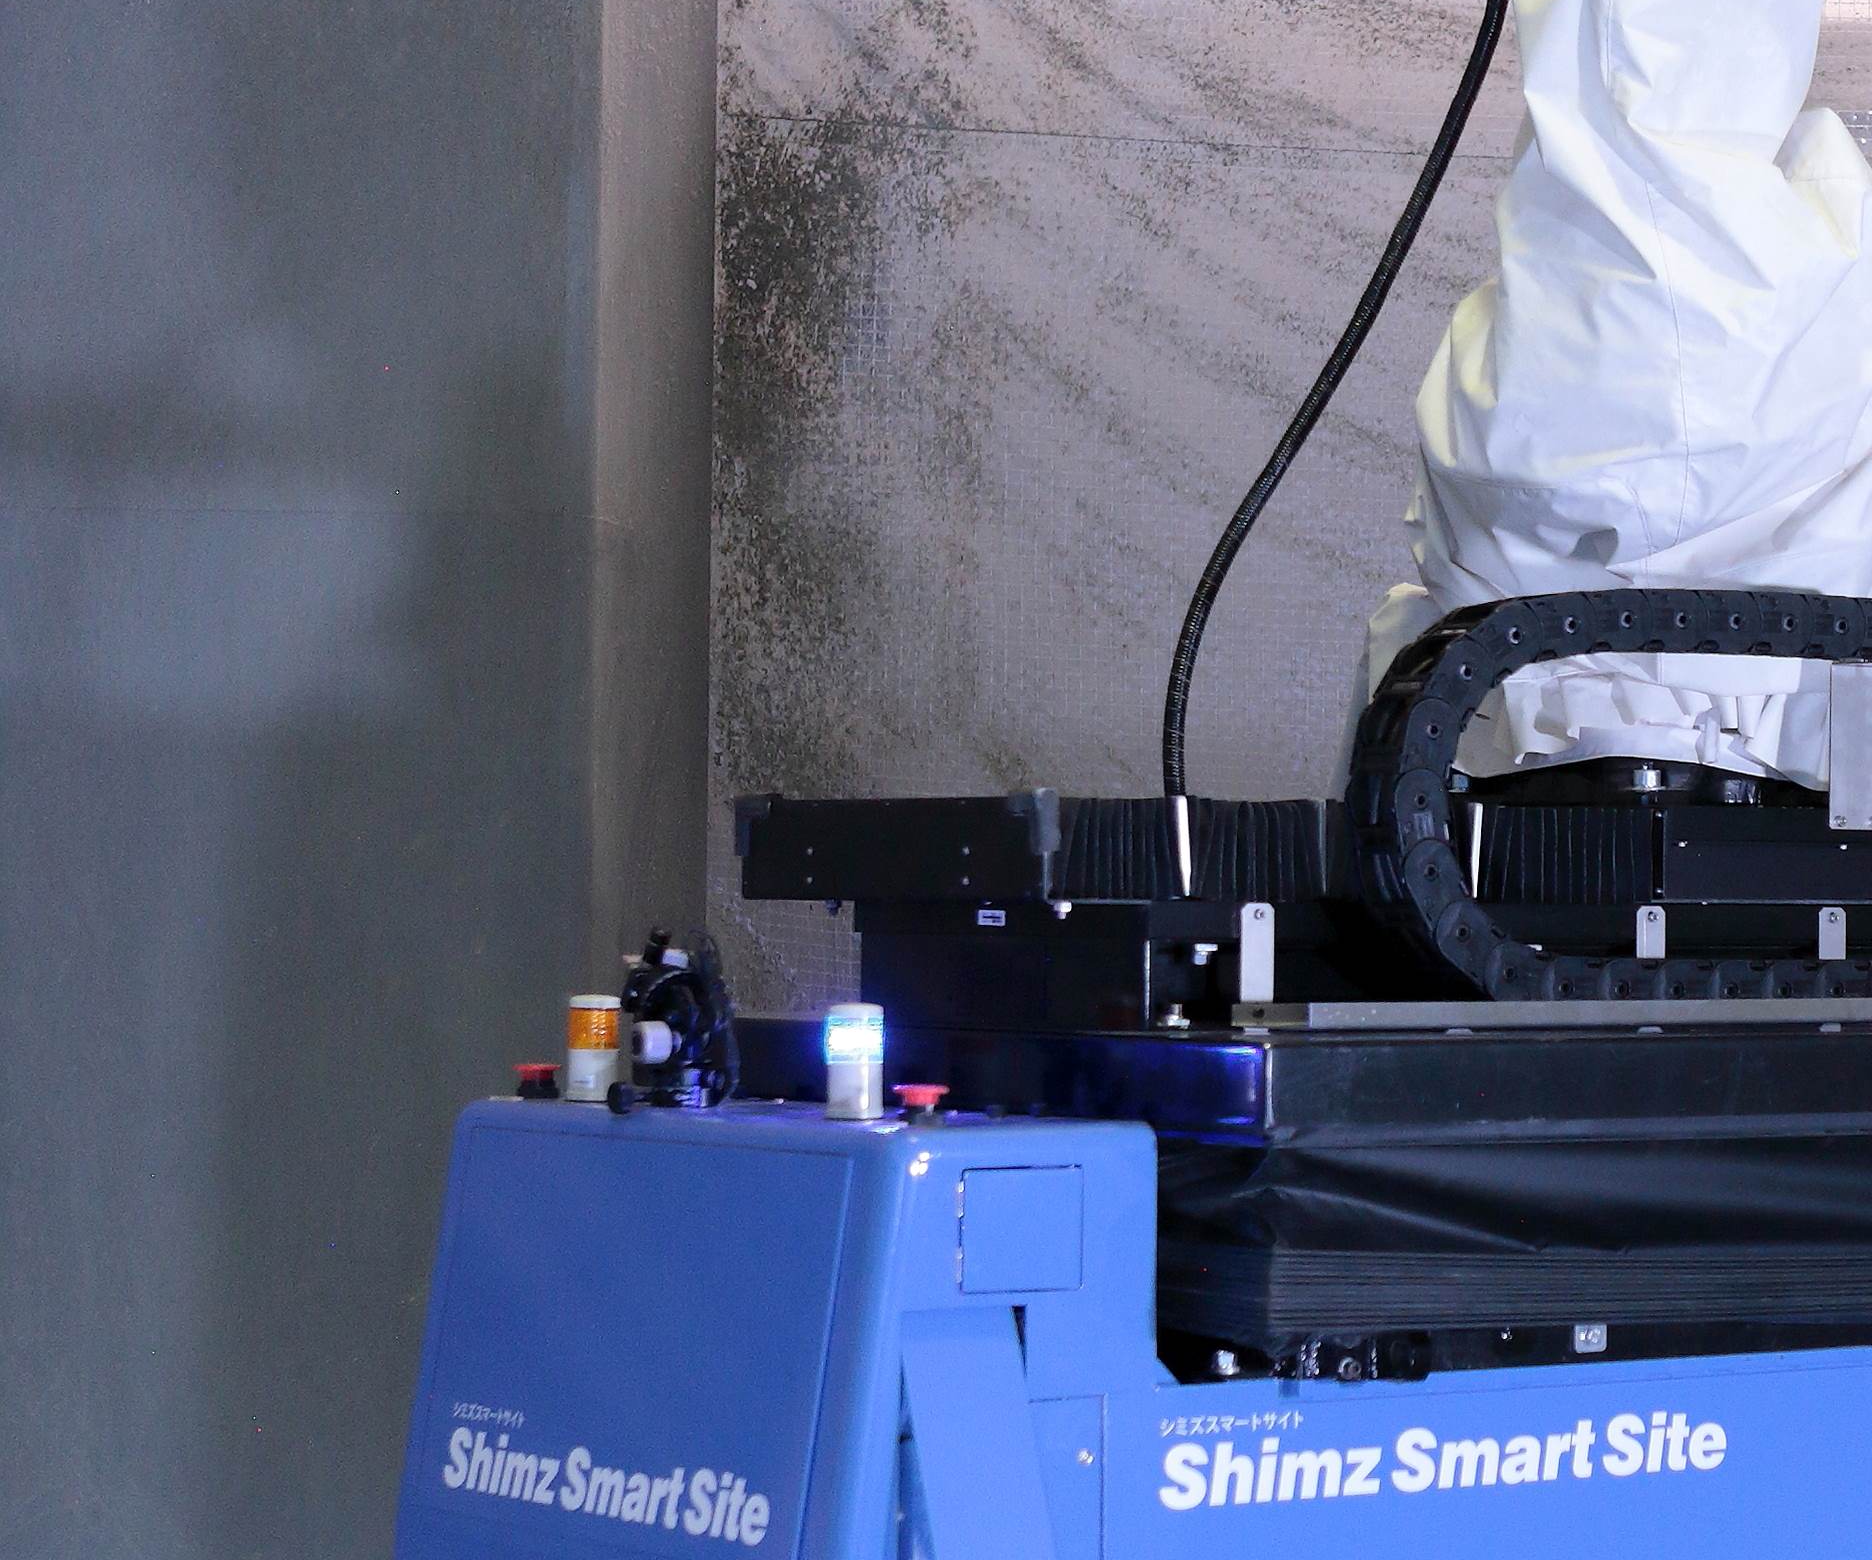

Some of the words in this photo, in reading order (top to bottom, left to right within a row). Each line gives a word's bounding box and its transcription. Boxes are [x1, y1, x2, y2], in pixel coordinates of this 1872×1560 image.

[1158, 1436, 1382, 1511] Shimz
[1390, 1419, 1596, 1493] Smart
[1602, 1410, 1727, 1477] Site
[1159, 1410, 1304, 1438] シミズスマートサイト
[443, 1426, 561, 1505] Shimz
[560, 1446, 686, 1530] Smart
[683, 1467, 770, 1547] Site
